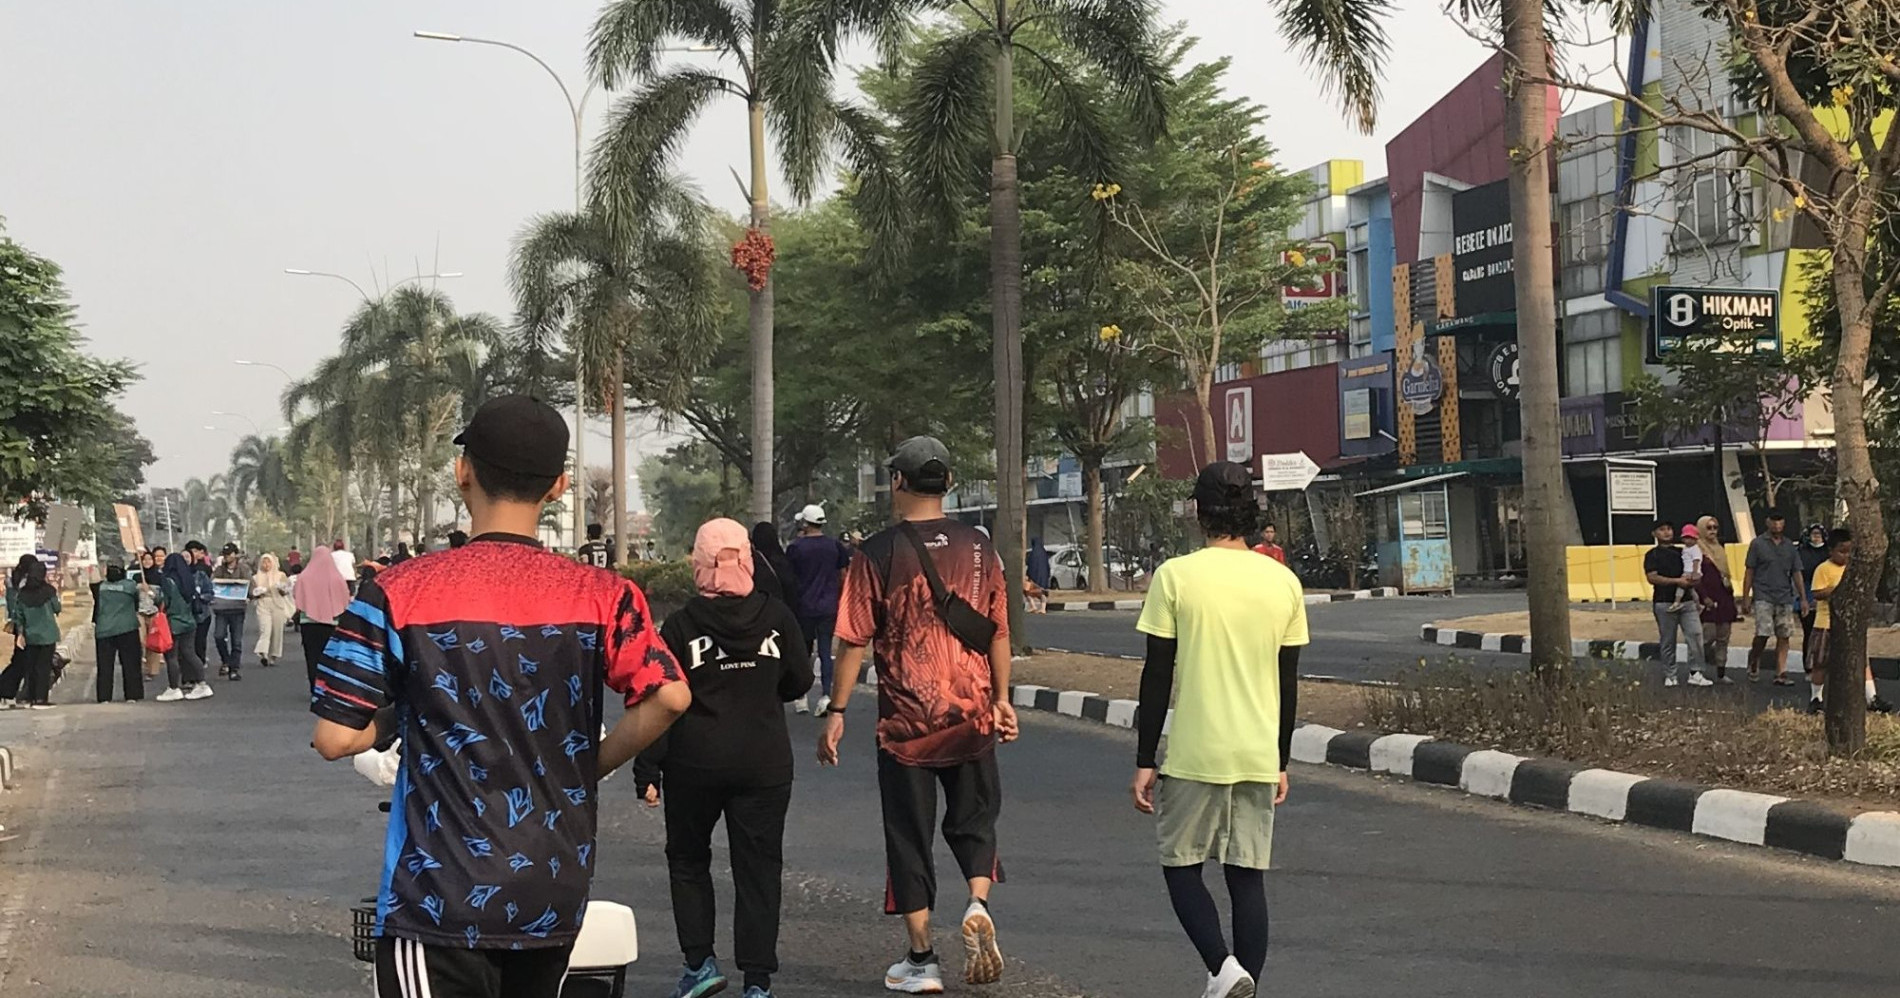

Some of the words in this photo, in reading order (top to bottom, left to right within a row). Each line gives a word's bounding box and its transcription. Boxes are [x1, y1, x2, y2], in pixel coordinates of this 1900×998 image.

[1702, 295, 1773, 317] HIKMAH
[1722, 316, 1755, 332] Optik
[720, 662, 739, 671] LOVE
